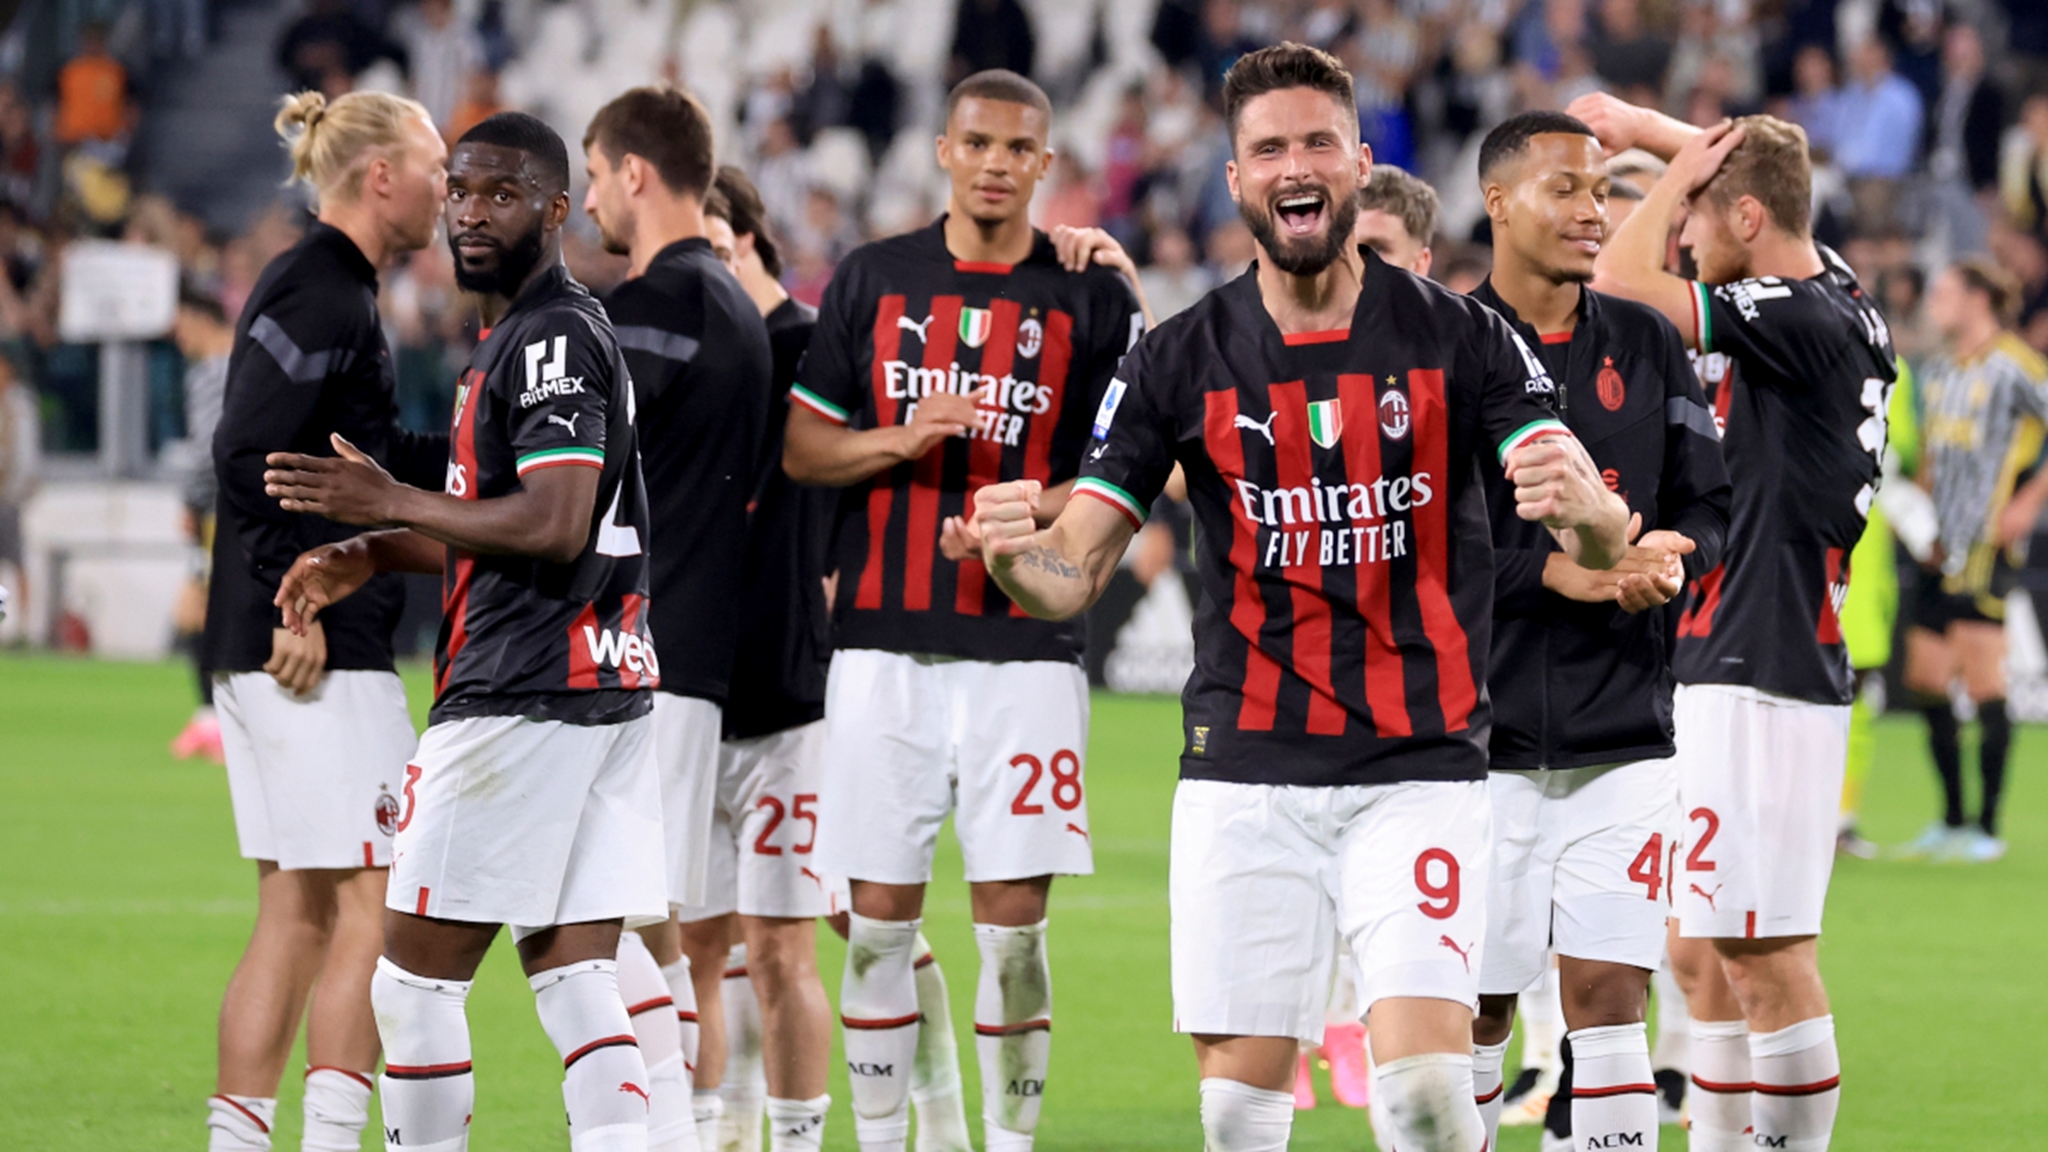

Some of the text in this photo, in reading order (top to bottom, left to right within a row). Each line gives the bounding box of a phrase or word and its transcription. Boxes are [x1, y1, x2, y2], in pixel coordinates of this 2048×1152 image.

[519, 376, 586, 409] BitMEX
[883, 359, 1053, 415] Emirates
[1234, 472, 1433, 526] Emirates
[1264, 520, 1407, 567] FLY BETTER
[397, 763, 422, 833] 3
[1009, 748, 1082, 816] 28
[753, 793, 818, 856] 25
[1686, 806, 1720, 872] 2
[1413, 846, 1461, 920] 9
[1627, 832, 1677, 908] 4
[1587, 1131, 1644, 1150] ACM
[1754, 1132, 1788, 1149] CM
